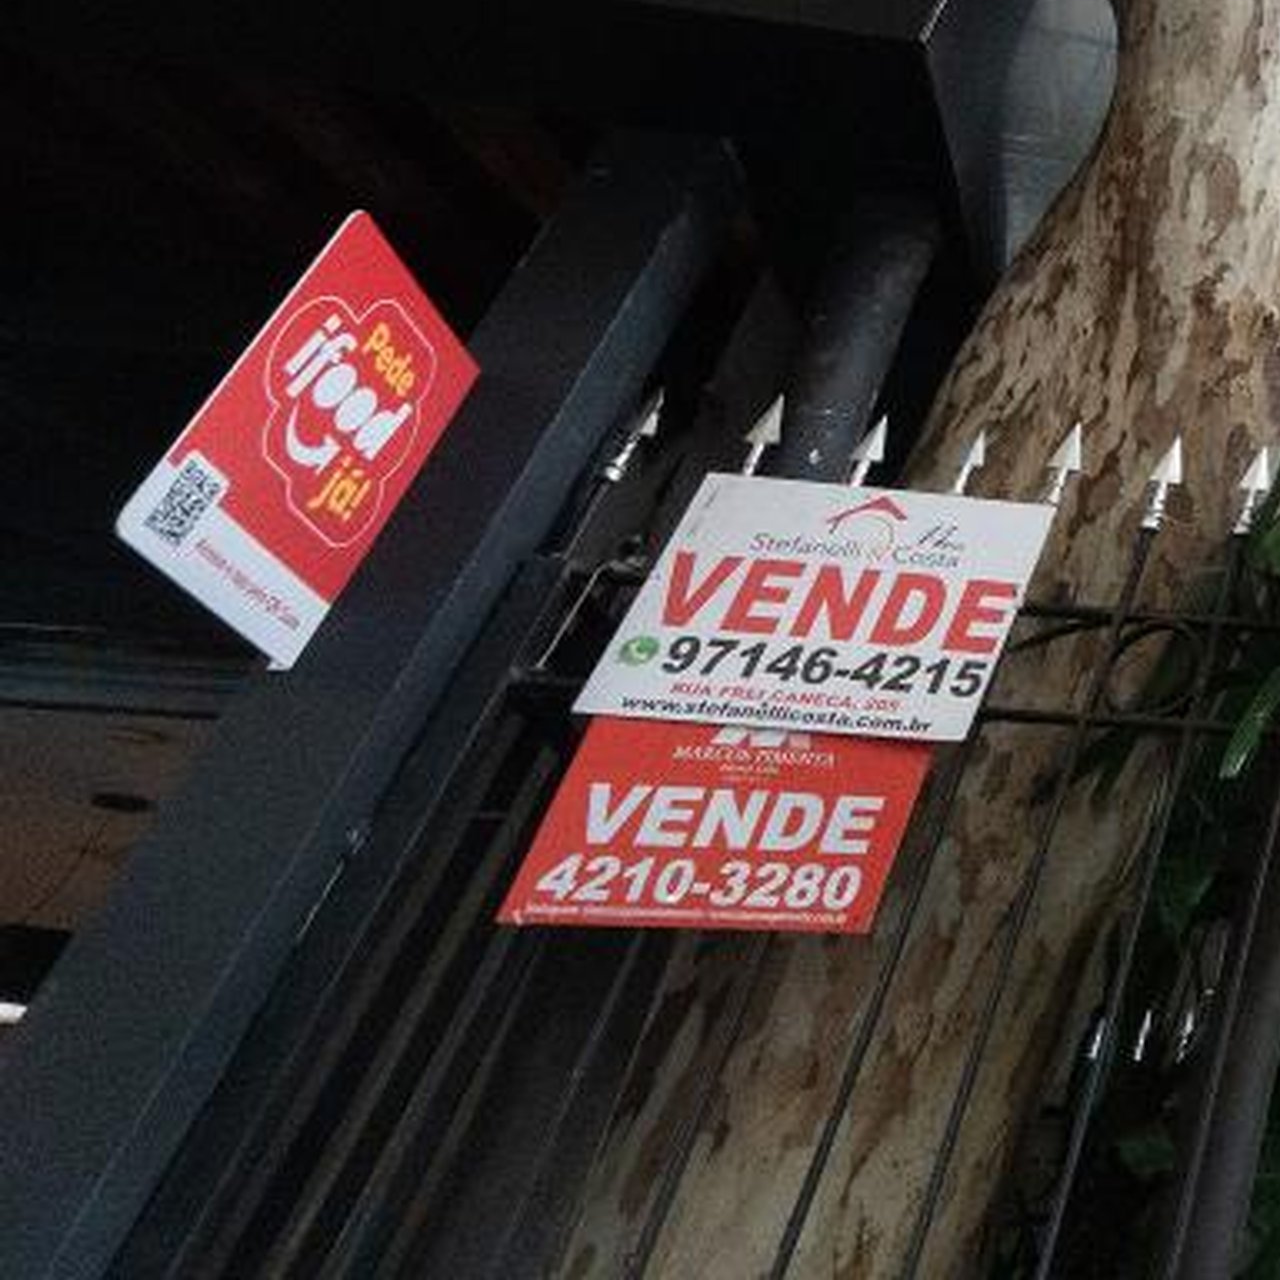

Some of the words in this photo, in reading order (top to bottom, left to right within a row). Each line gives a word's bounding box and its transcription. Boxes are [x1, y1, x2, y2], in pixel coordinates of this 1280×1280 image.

[308, 456, 372, 521] já!
[658, 551, 1018, 654] VENDE
[660, 635, 987, 697] 97146-4215
[584, 782, 885, 855] VENDE
[535, 853, 861, 910] 4210-3280
